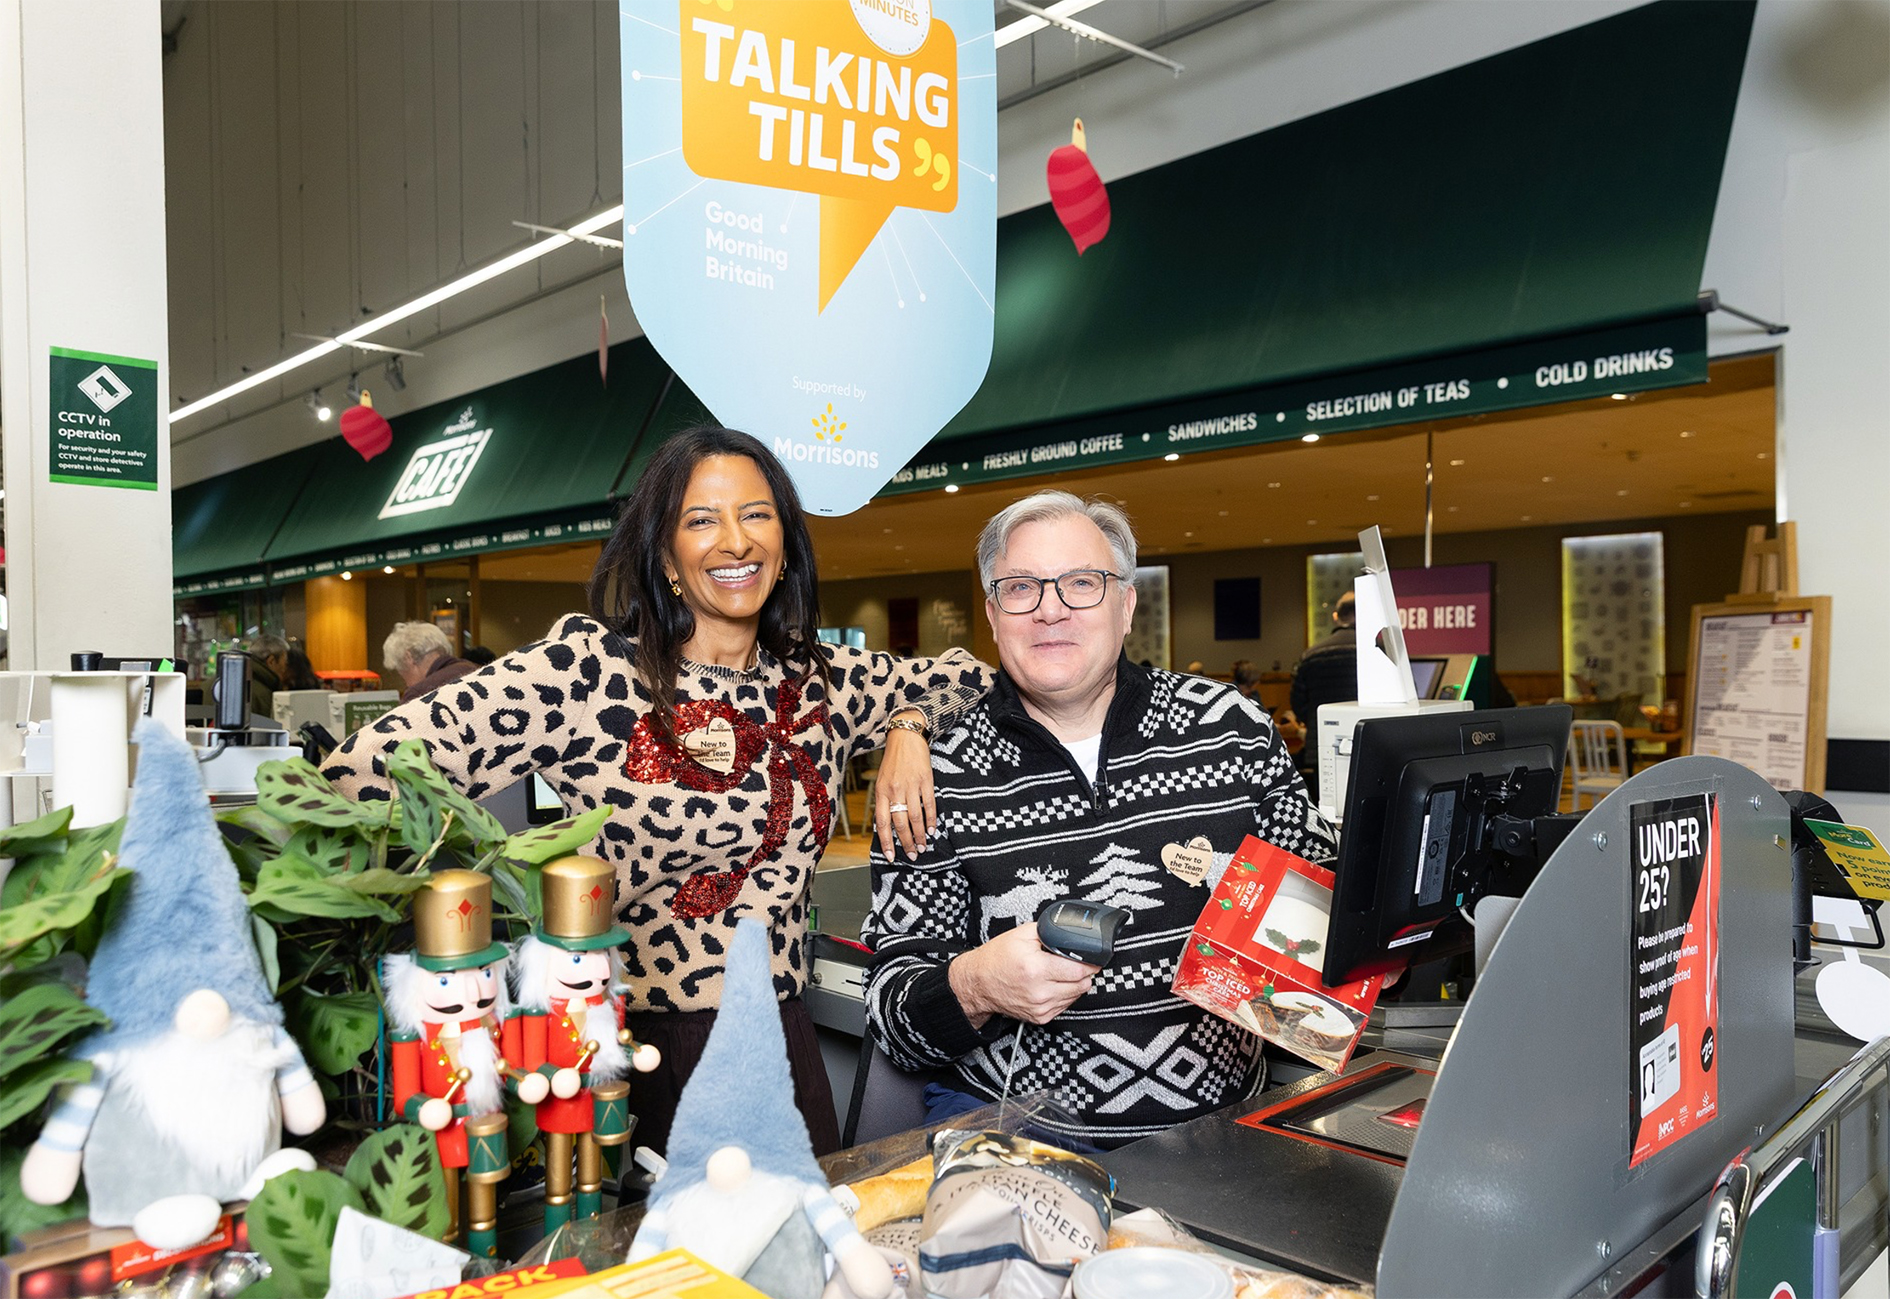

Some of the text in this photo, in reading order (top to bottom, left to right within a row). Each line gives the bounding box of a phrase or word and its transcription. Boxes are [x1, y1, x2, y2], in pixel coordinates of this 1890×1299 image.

[691, 16, 949, 128] TALKING
[748, 101, 901, 181] TILLS
[705, 201, 763, 234] Good
[706, 227, 788, 271] Morning
[706, 255, 774, 290] Britain
[792, 375, 867, 403] Supported by
[58, 411, 111, 427] CCTV in
[915, 462, 949, 480] MEALS
[983, 447, 1028, 470] FRESHLY
[1031, 439, 1077, 463] GROUND
[1080, 433, 1123, 455] COFFEE
[1168, 412, 1257, 442] SANDWICHES
[1306, 391, 1392, 421] SELECTION
[1398, 387, 1420, 408] OF
[1424, 379, 1470, 405] TEAS
[1535, 360, 1587, 388] COLD
[1594, 347, 1674, 379] DRINKS
[58, 427, 121, 442] operation
[58, 443, 70, 451] For
[71, 445, 97, 455] security
[98, 447, 111, 455] and
[127, 450, 147, 459] safety
[111, 456, 144, 467] detectives
[774, 437, 879, 469] Morrisons
[58, 462, 85, 470] operate
[1433, 605, 1476, 628] HERE
[1639, 816, 1701, 867] UNDER
[1847, 838, 1872, 847] Card
[1170, 860, 1203, 873] the Team
[1175, 853, 1192, 862] New
[1836, 851, 1866, 862] Now
[1846, 860, 1859, 869] 5
[1239, 894, 1251, 909] TOP
[1639, 865, 1670, 913] 25?
[1638, 934, 1658, 949] Please
[1664, 922, 1686, 943] prepared
[1686, 922, 1694, 933] to
[1639, 960, 1655, 974] show
[1655, 952, 1667, 971] proof
[1681, 945, 1699, 957] when
[1202, 966, 1225, 981] TOP
[1226, 978, 1251, 995] ICED
[1640, 982, 1658, 999] buying
[1667, 967, 1691, 987] restricted
[1640, 1003, 1664, 1026] products
[1034, 1200, 1100, 1257] CHEESE
